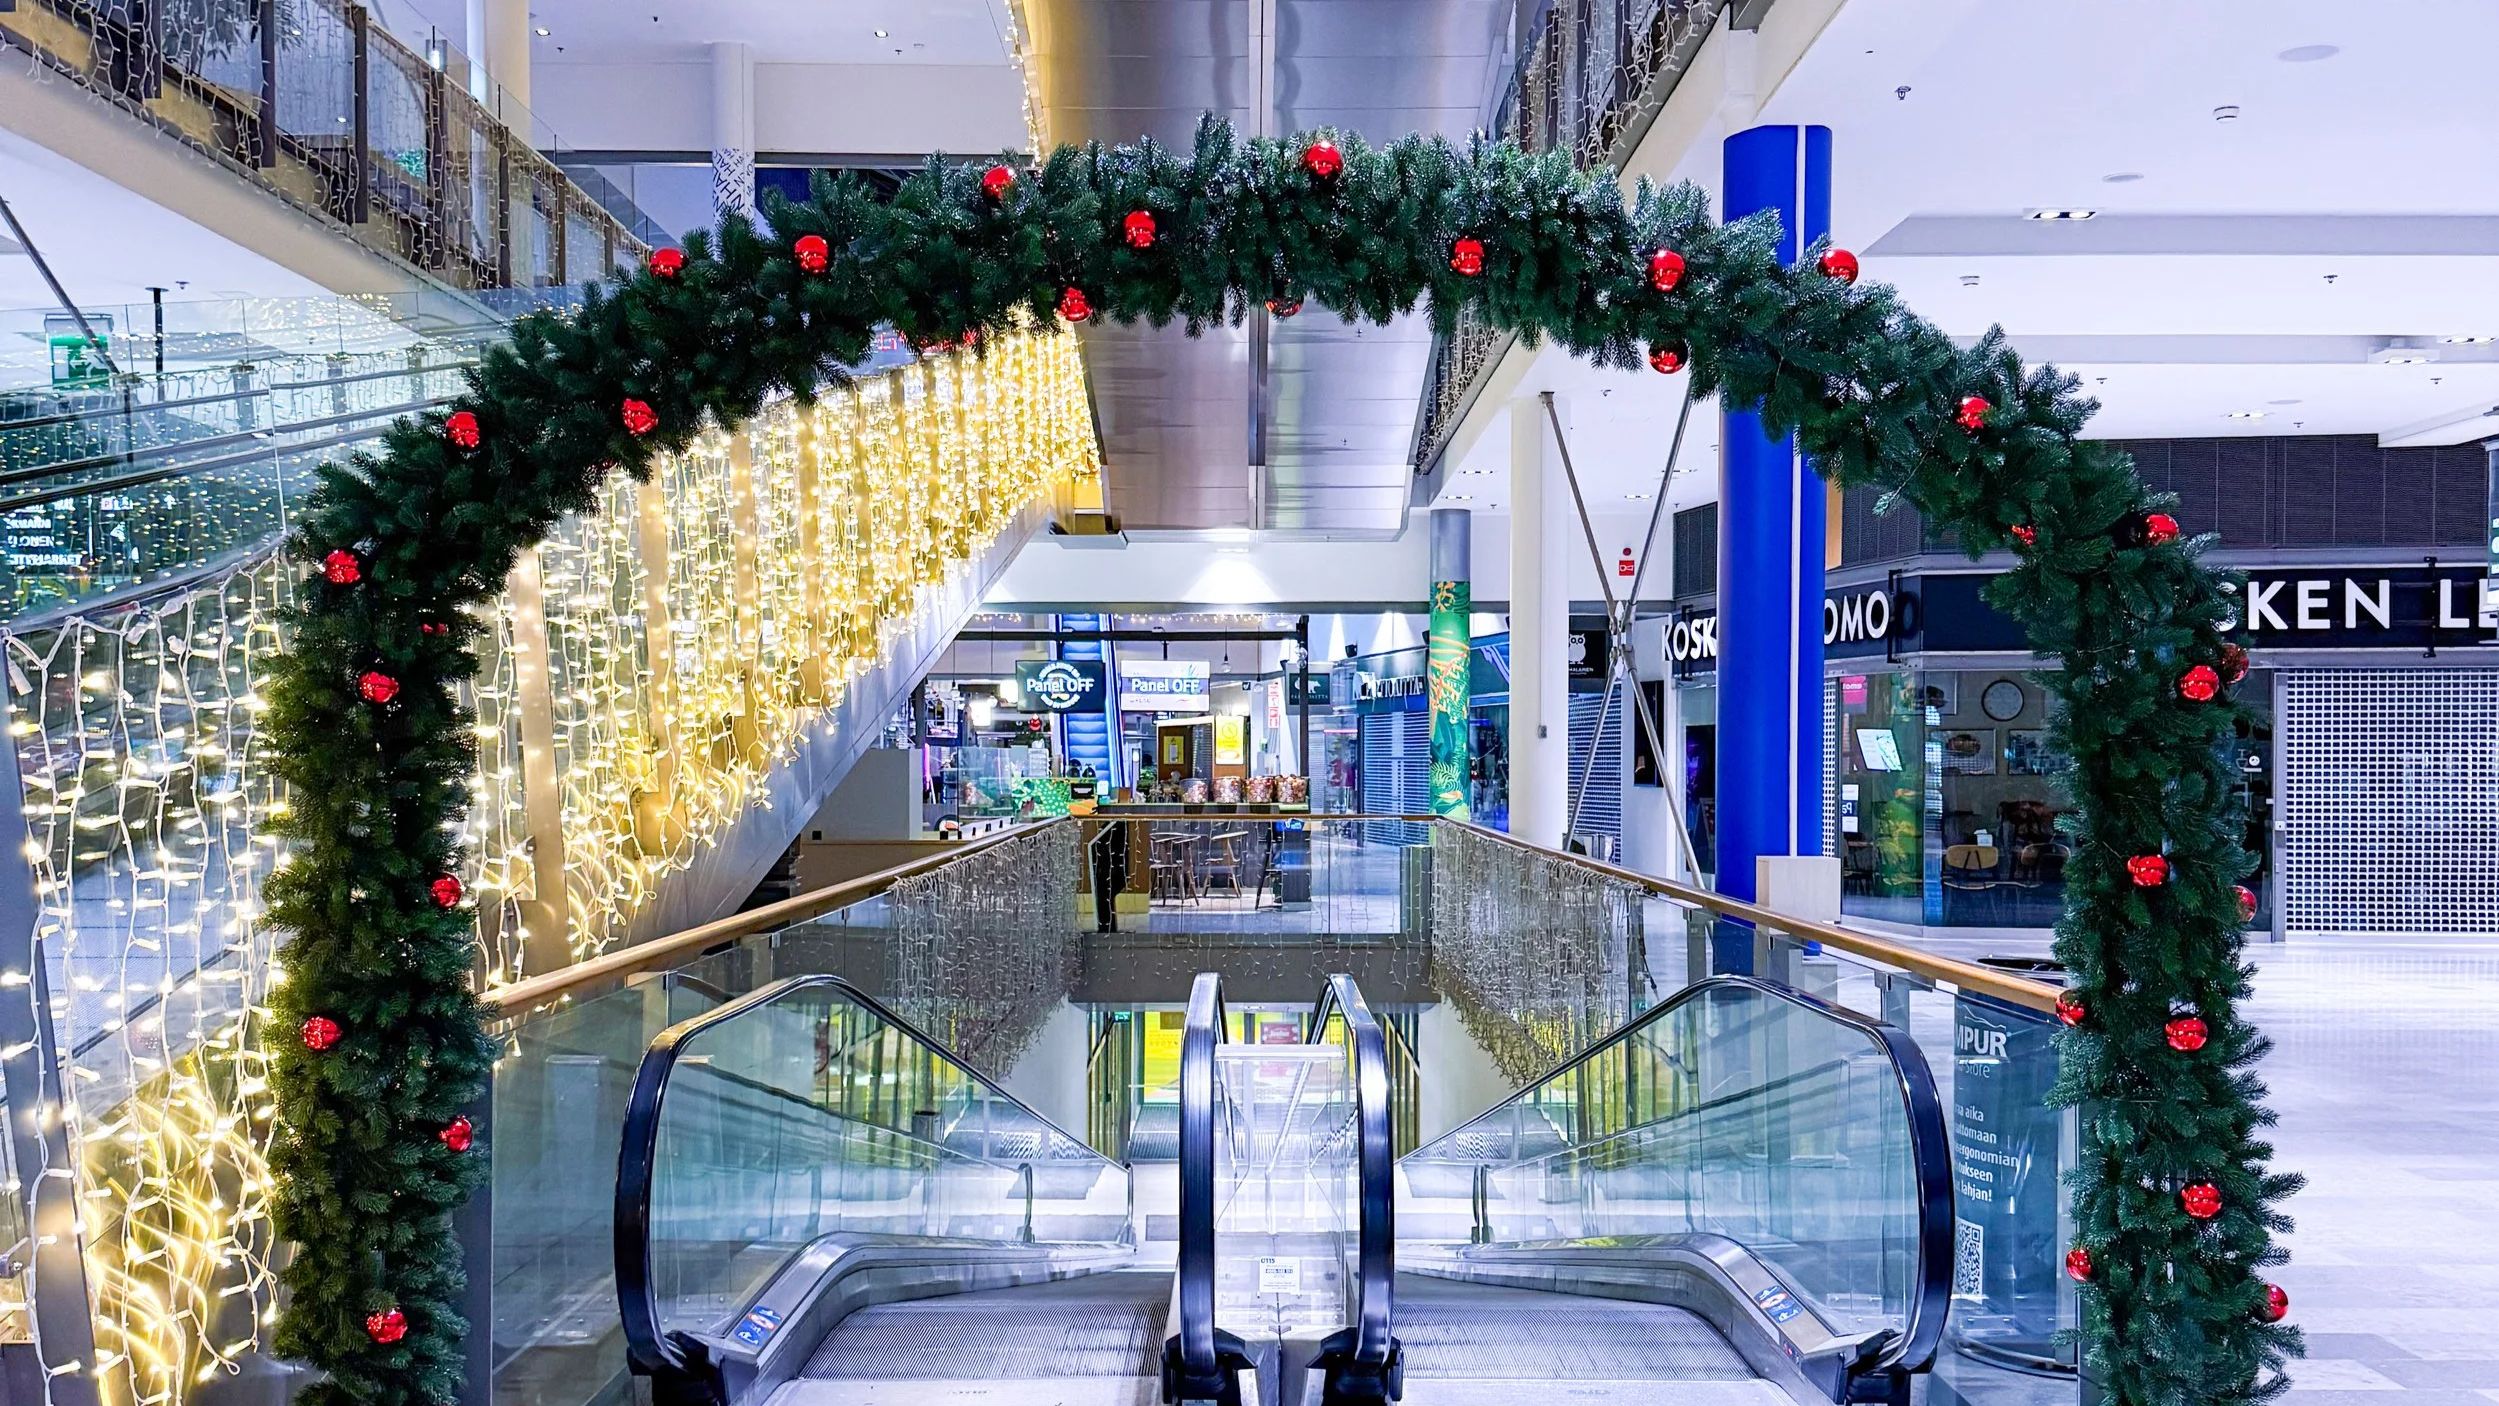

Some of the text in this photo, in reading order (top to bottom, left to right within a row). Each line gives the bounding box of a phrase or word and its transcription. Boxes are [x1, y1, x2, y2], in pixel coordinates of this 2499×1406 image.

[1661, 616, 1717, 662] KOSK
[1026, 678, 1095, 693] Panel OFF
[1131, 678, 1200, 693] Panel OFF
[1965, 1105, 1984, 1122] aika
